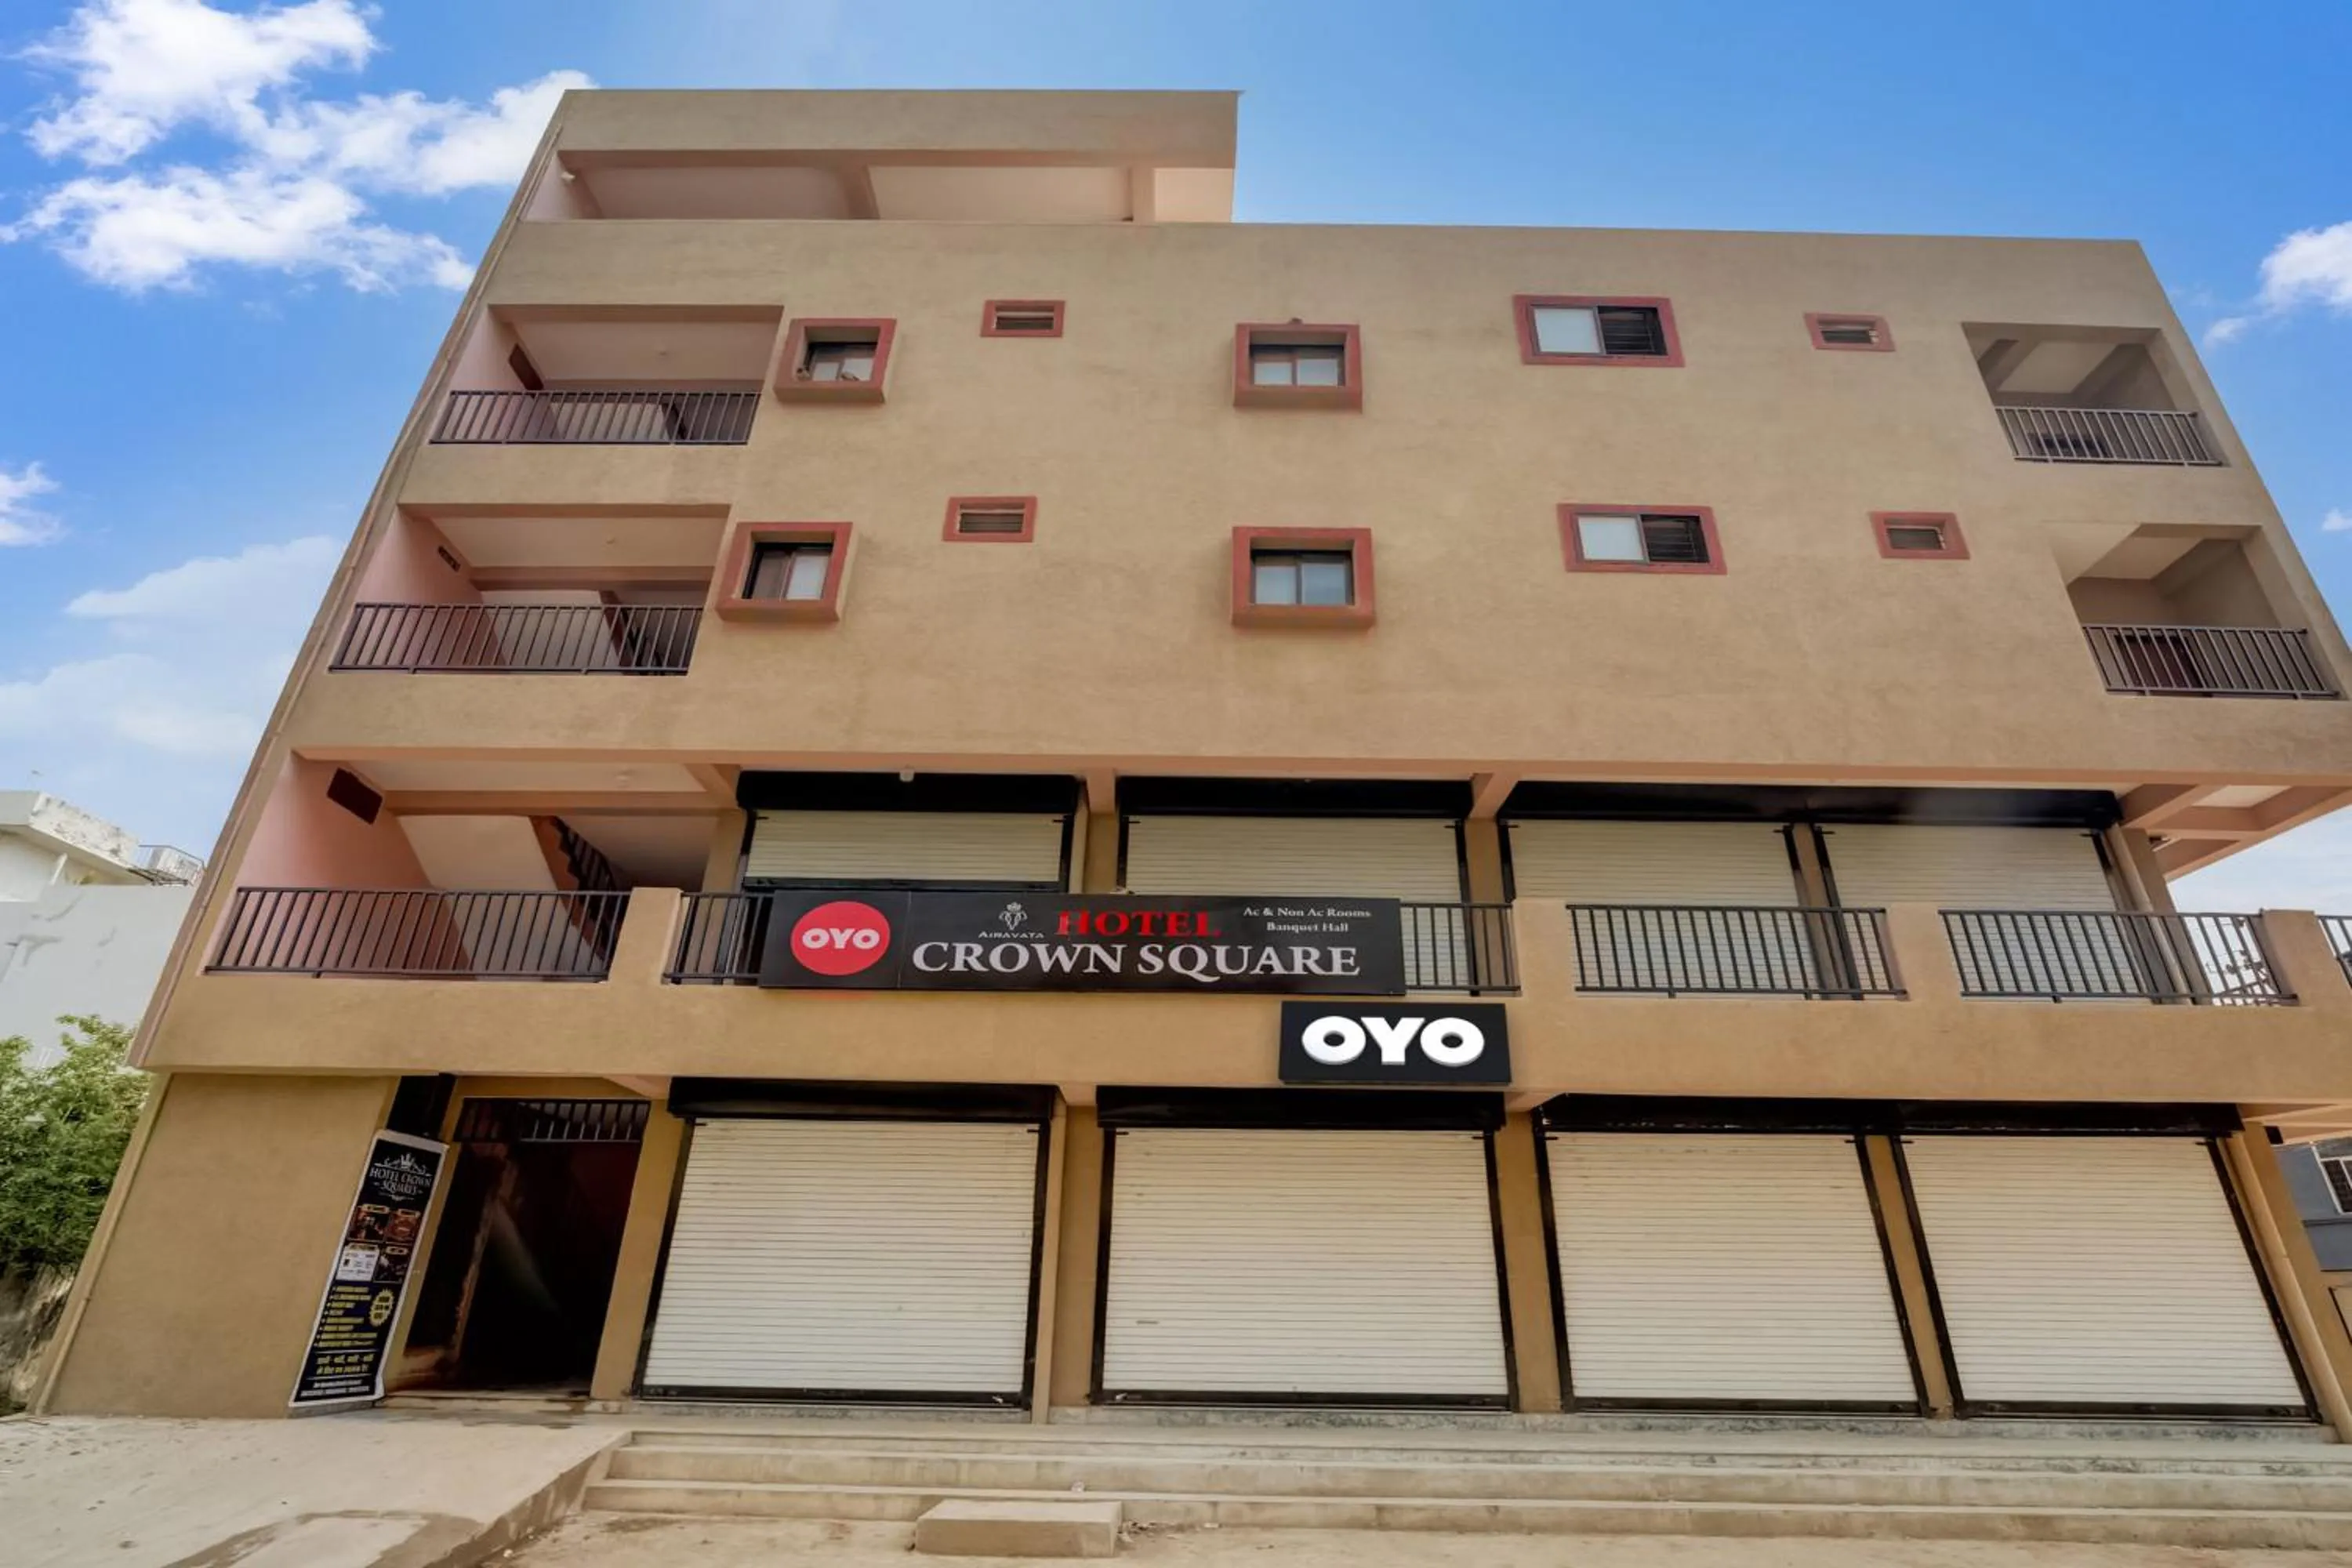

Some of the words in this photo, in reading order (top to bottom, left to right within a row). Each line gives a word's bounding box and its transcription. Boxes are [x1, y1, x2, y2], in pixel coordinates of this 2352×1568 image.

[1055, 909, 1222, 938] HOTEL
[1263, 907, 1273, 916] &
[1277, 907, 1304, 917] Non
[1327, 908, 1371, 918] Rooms
[802, 927, 880, 950] OYO
[1266, 921, 1319, 934] Banquet
[1323, 922, 1348, 932] Hall
[912, 942, 1127, 974] CROWN
[1137, 943, 1361, 983] SQUARE
[1301, 1015, 1485, 1067] OYO
